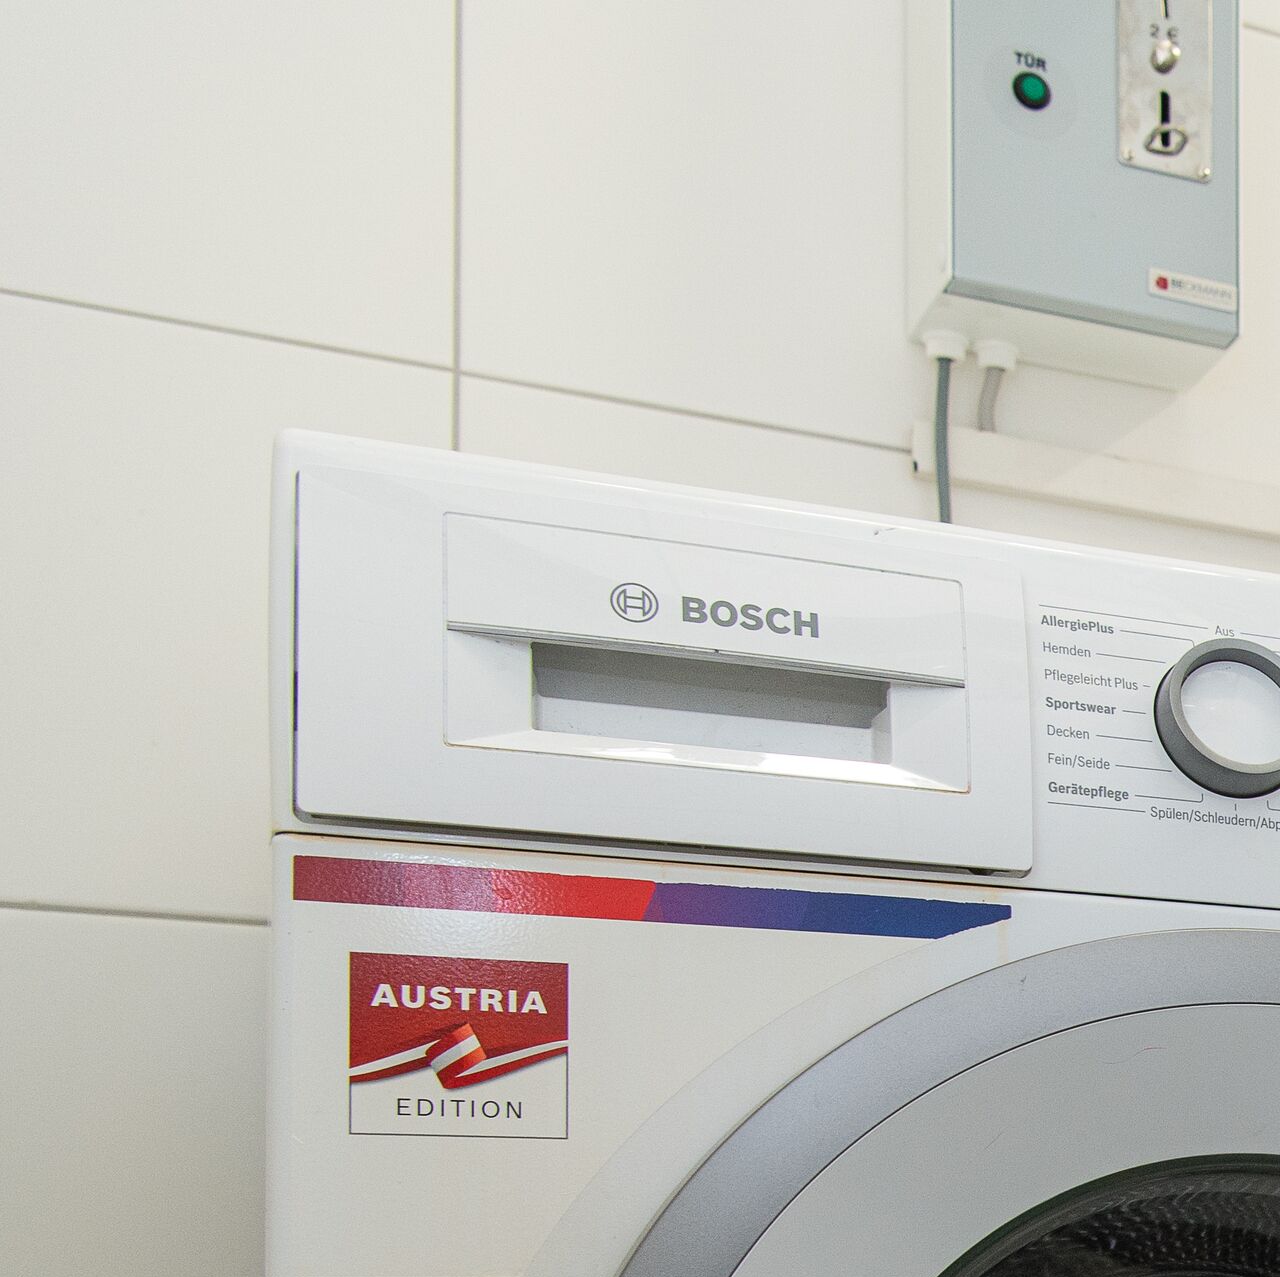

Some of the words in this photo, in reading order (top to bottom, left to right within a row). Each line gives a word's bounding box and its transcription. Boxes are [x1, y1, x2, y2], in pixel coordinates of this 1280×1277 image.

[682, 596, 819, 638] BOSCH
[1040, 614, 1115, 634] AllergiePlus
[1215, 625, 1235, 637] Aus
[1043, 641, 1092, 658] Hemden
[1044, 668, 1112, 688] Pflegeleicht
[1114, 676, 1139, 691] Plus
[1045, 696, 1116, 715] Sportswear
[1047, 724, 1090, 740] Decken
[1048, 752, 1110, 770] Fein/Seide
[1048, 781, 1129, 801] Gerätepflege
[370, 983, 548, 1014] AUSTRIA
[396, 1097, 523, 1119] EDITION
